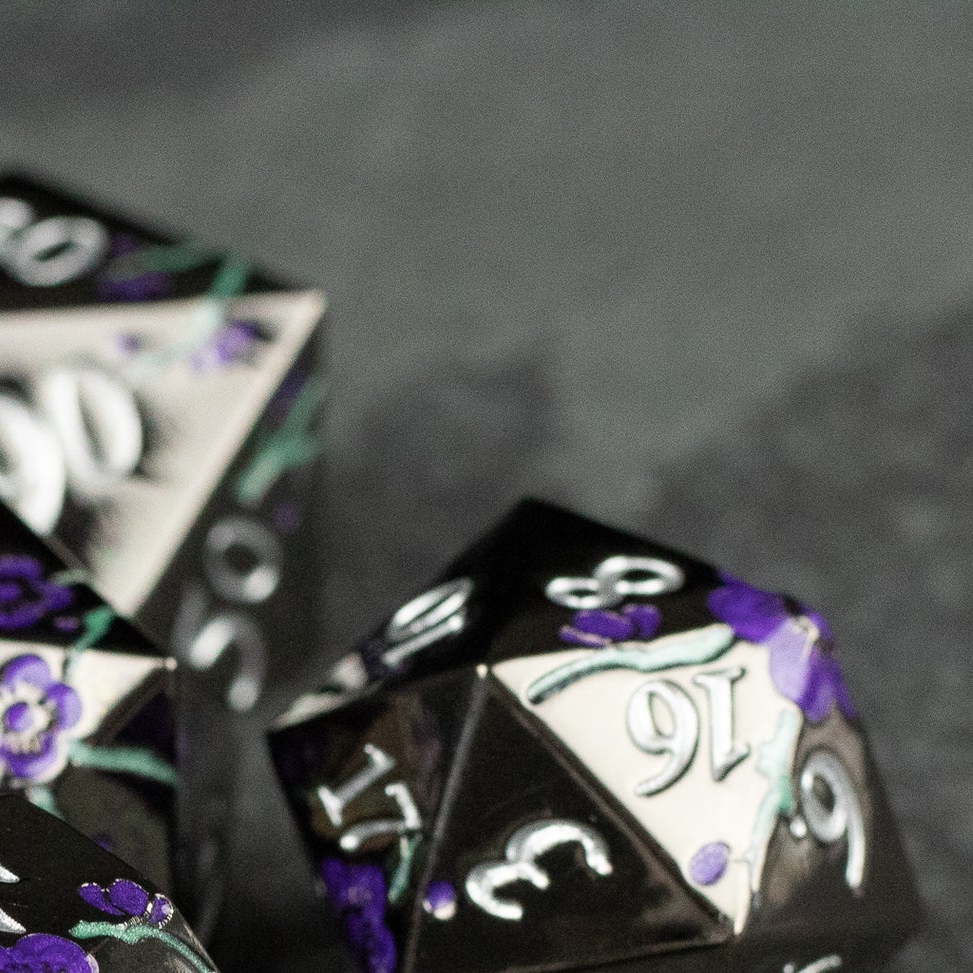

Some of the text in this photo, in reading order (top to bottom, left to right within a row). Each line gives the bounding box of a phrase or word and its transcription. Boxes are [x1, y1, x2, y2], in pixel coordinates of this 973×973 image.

[545, 554, 685, 611] 8
[627, 667, 750, 799] 16
[317, 743, 423, 850] 17
[465, 818, 614, 922] 3
